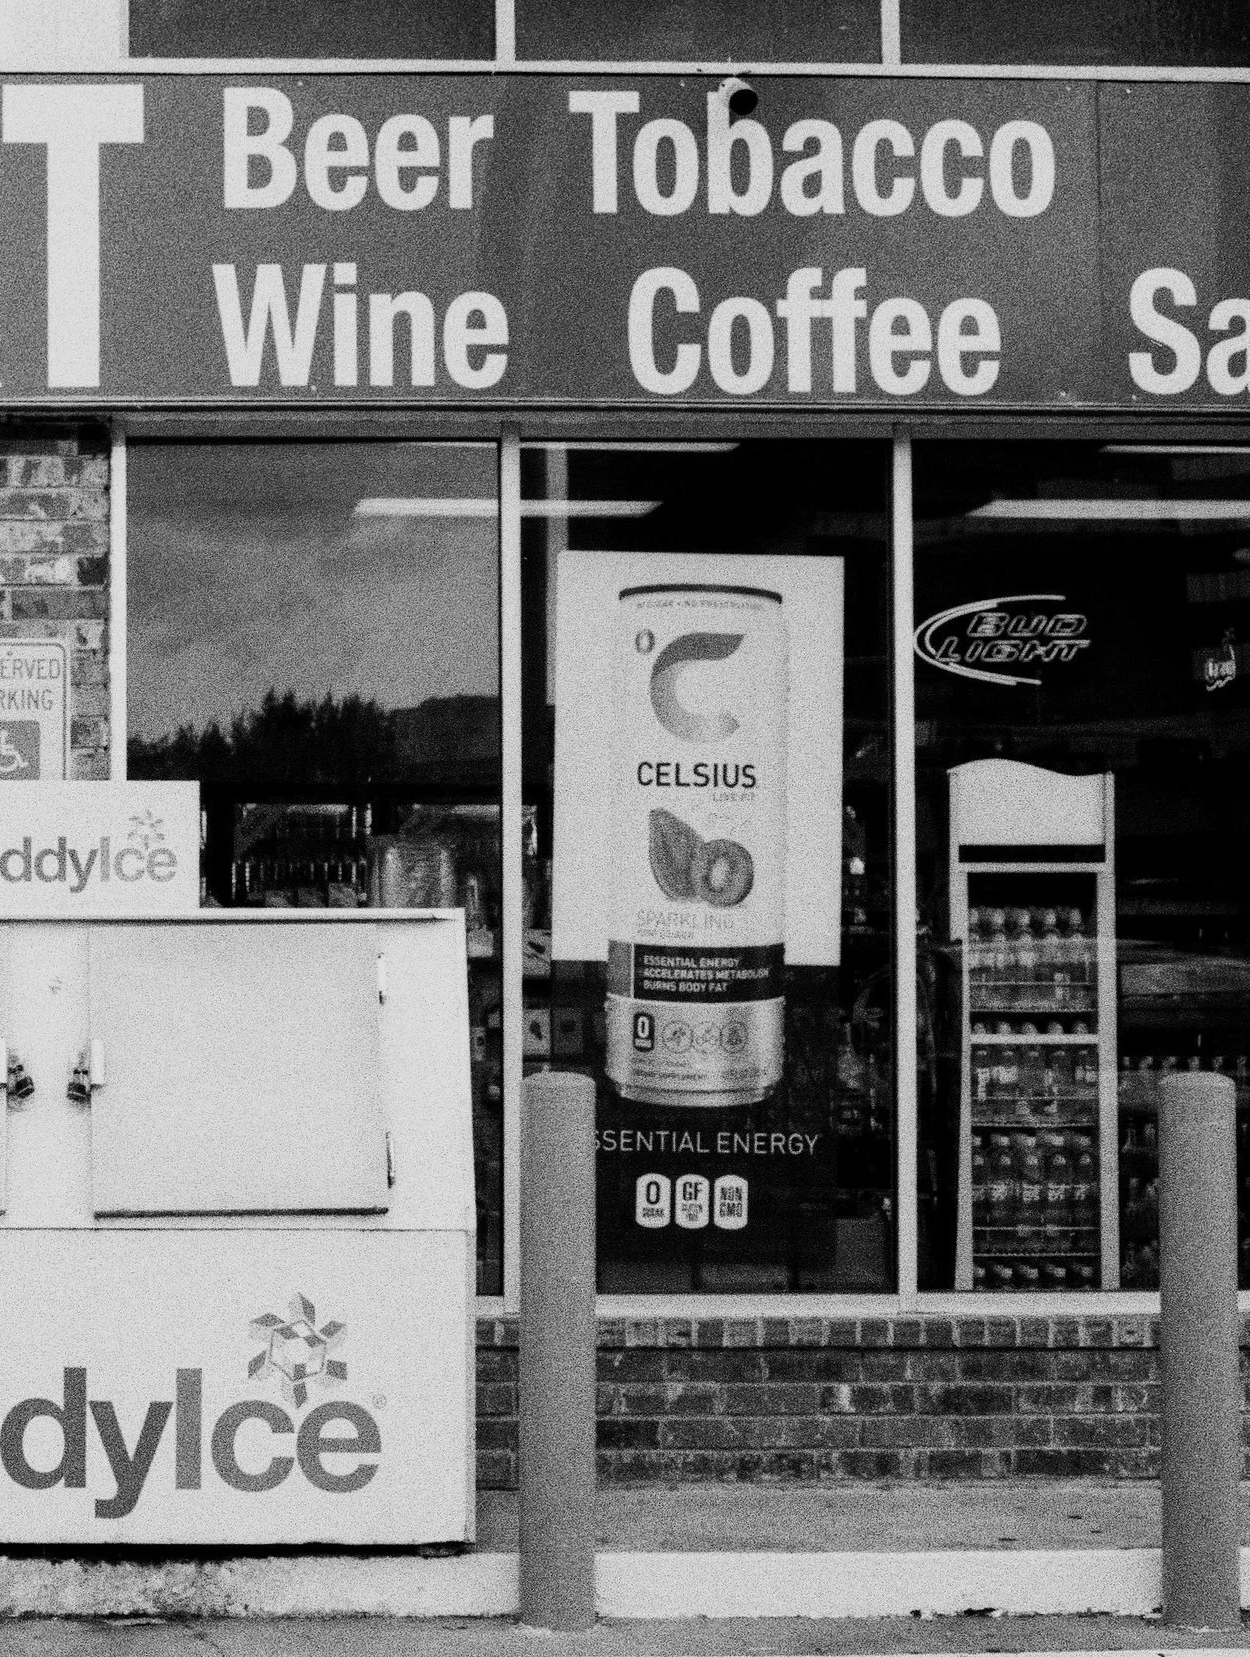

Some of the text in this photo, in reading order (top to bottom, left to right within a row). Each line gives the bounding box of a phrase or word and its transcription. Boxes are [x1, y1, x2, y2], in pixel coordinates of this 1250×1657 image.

[224, 86, 1055, 218] Beer Tobacco
[212, 262, 509, 389] Wine
[627, 267, 1001, 395] Coffee
[967, 612, 1087, 637] BUD
[934, 636, 1091, 662] LIGHT
[637, 761, 757, 789] CELSIUS
[643, 955, 740, 968] ESSENTIAL ENERGY
[643, 980, 728, 992] BURNS BODY FAT
[595, 1130, 819, 1155] SENTIAL ENERGY
[682, 1181, 703, 1201] GF
[720, 1186, 742, 1201] NON
[720, 1202, 743, 1217] GMO
